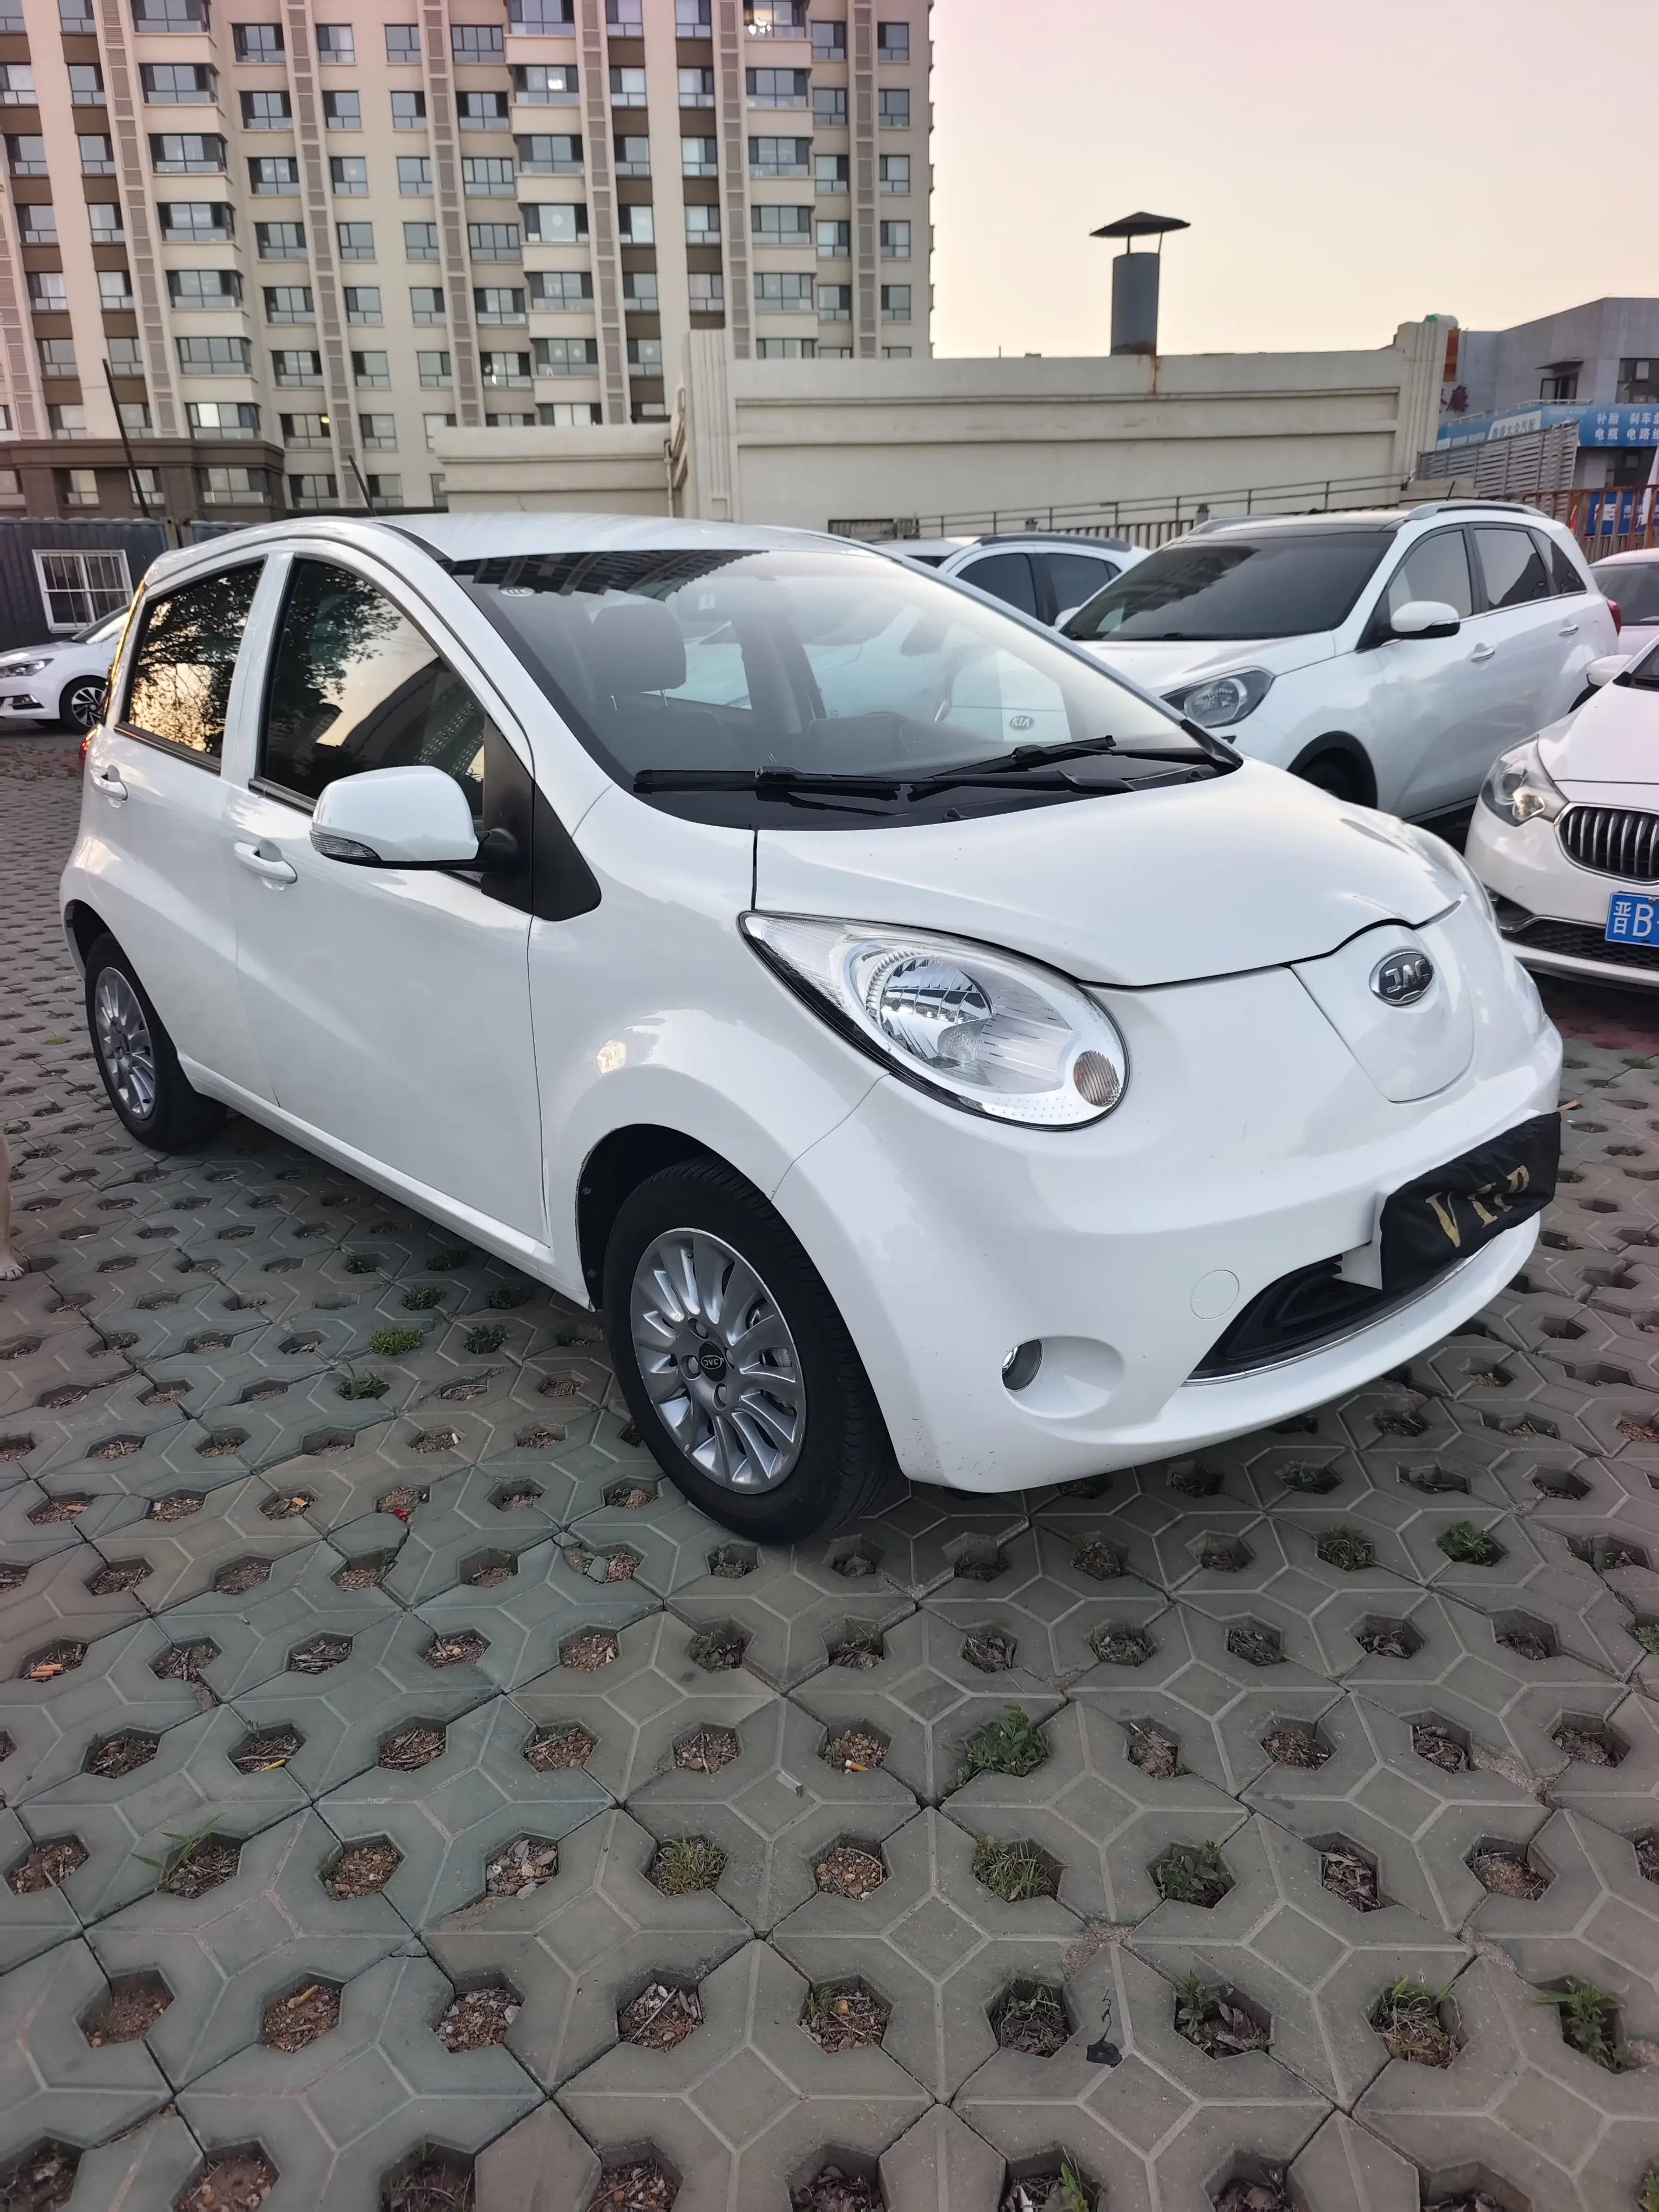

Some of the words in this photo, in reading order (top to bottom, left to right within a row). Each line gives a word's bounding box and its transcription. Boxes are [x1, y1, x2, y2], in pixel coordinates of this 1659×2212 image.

[1597, 412, 1619, 424] 补胎
[1595, 428, 1618, 440] 电瓶
[1011, 717, 1030, 727] KIA
[1613, 901, 1654, 937] 晋B
[1425, 1165, 1529, 1248] VIP
